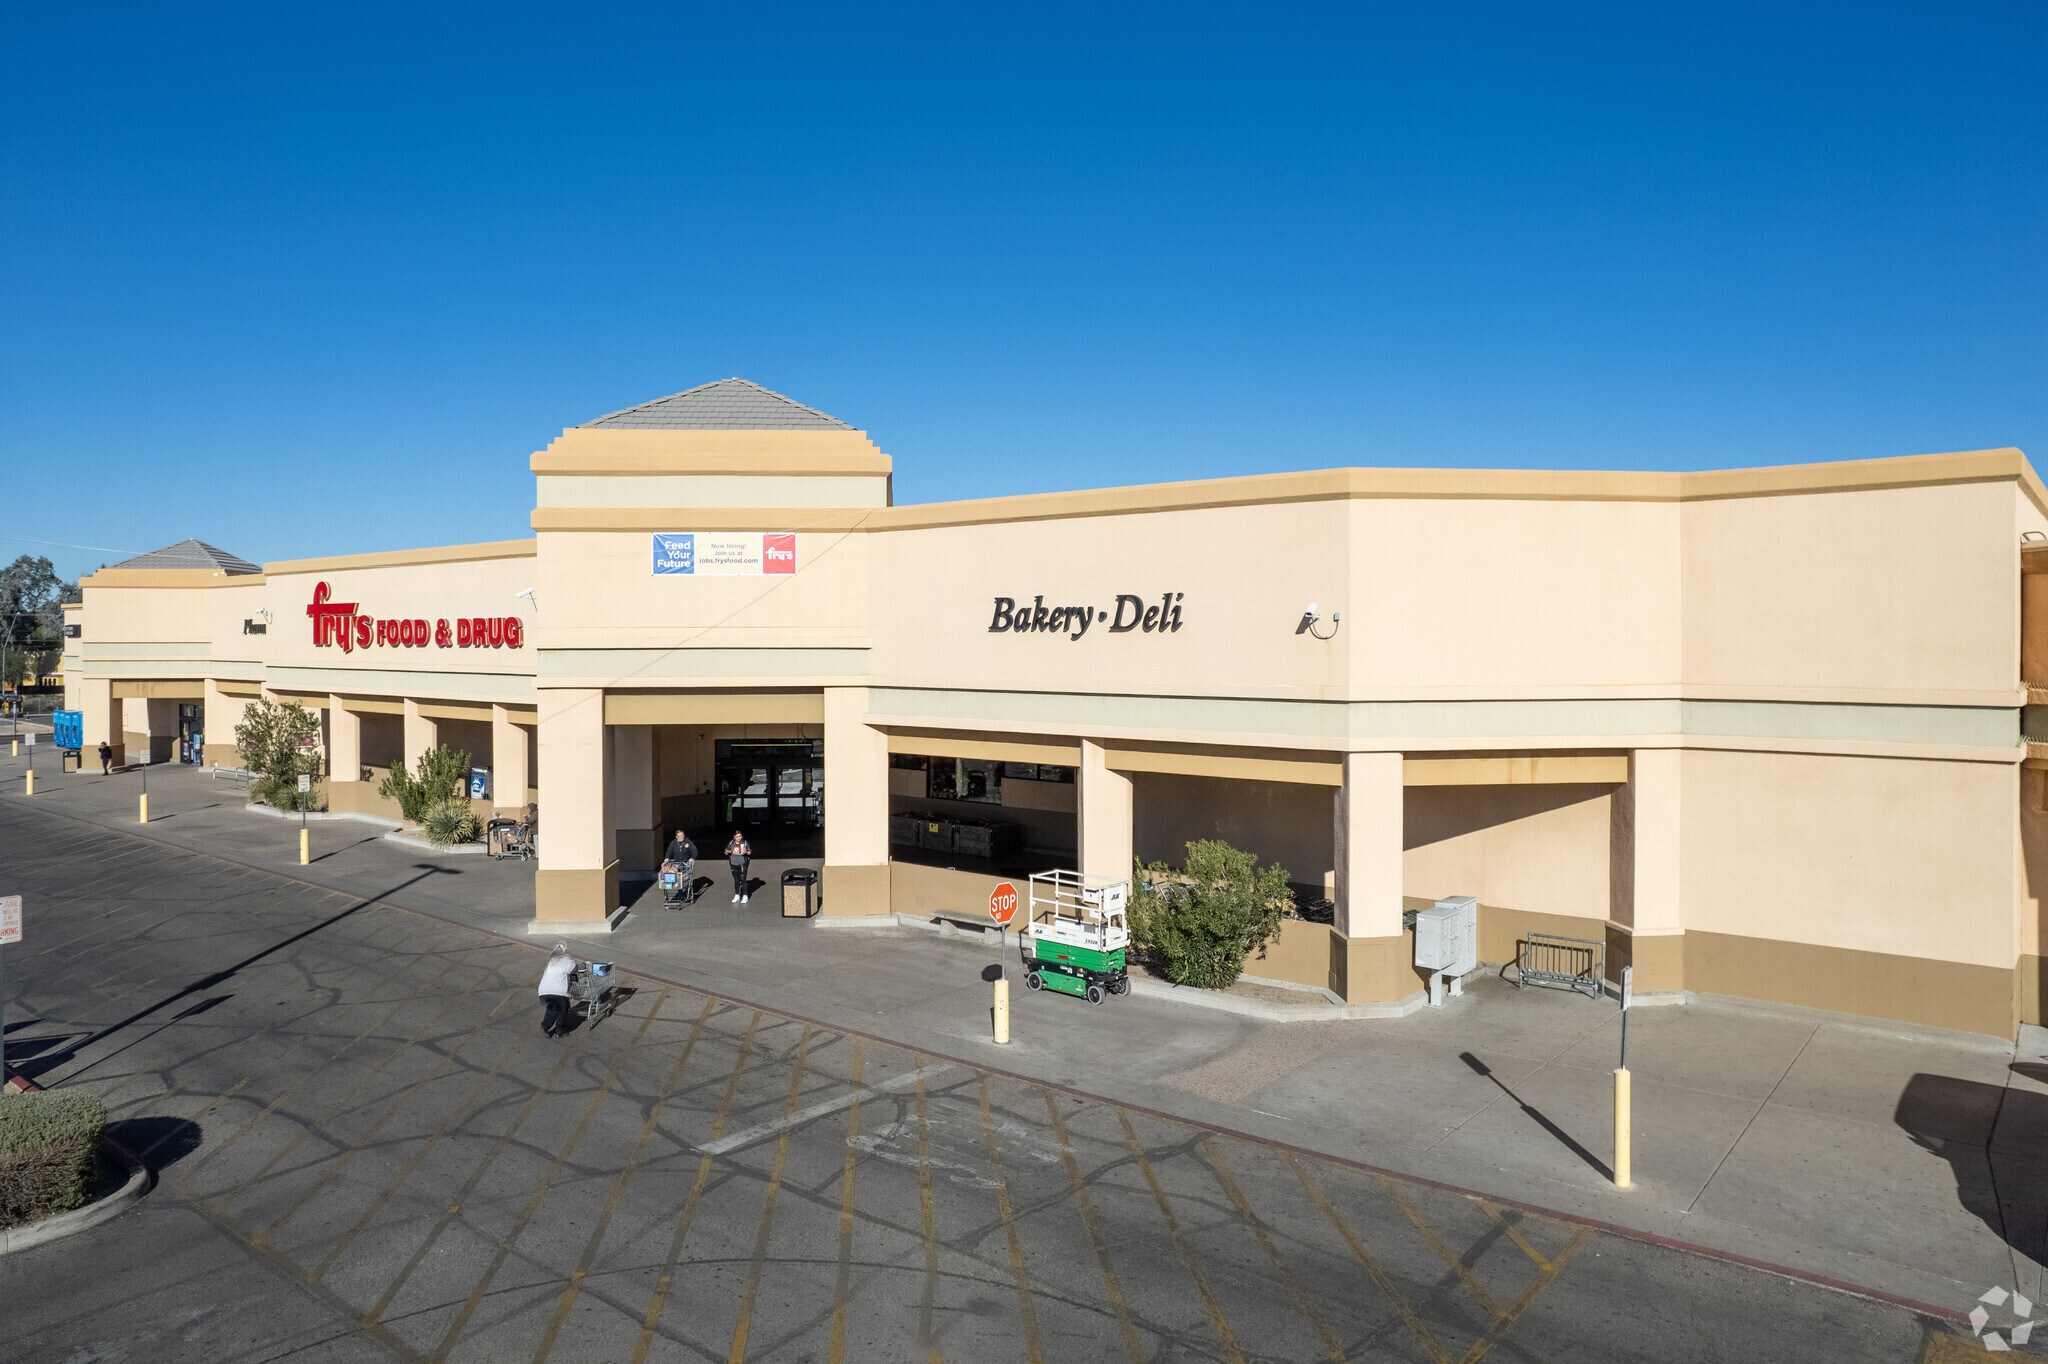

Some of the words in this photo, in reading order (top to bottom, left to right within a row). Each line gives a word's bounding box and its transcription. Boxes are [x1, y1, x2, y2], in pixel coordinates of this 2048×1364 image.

[665, 541, 691, 550] Feed
[726, 543, 747, 551] Hiring!
[667, 550, 691, 560] Your
[657, 560, 691, 568] Future
[699, 557, 759, 565] jobs.frysfood.com
[988, 595, 1094, 641] Bakery
[1108, 592, 1185, 633] Deli
[376, 618, 431, 649] FOOD
[434, 618, 453, 648] &
[456, 616, 524, 649] DRUG
[991, 894, 1016, 913] STOP
